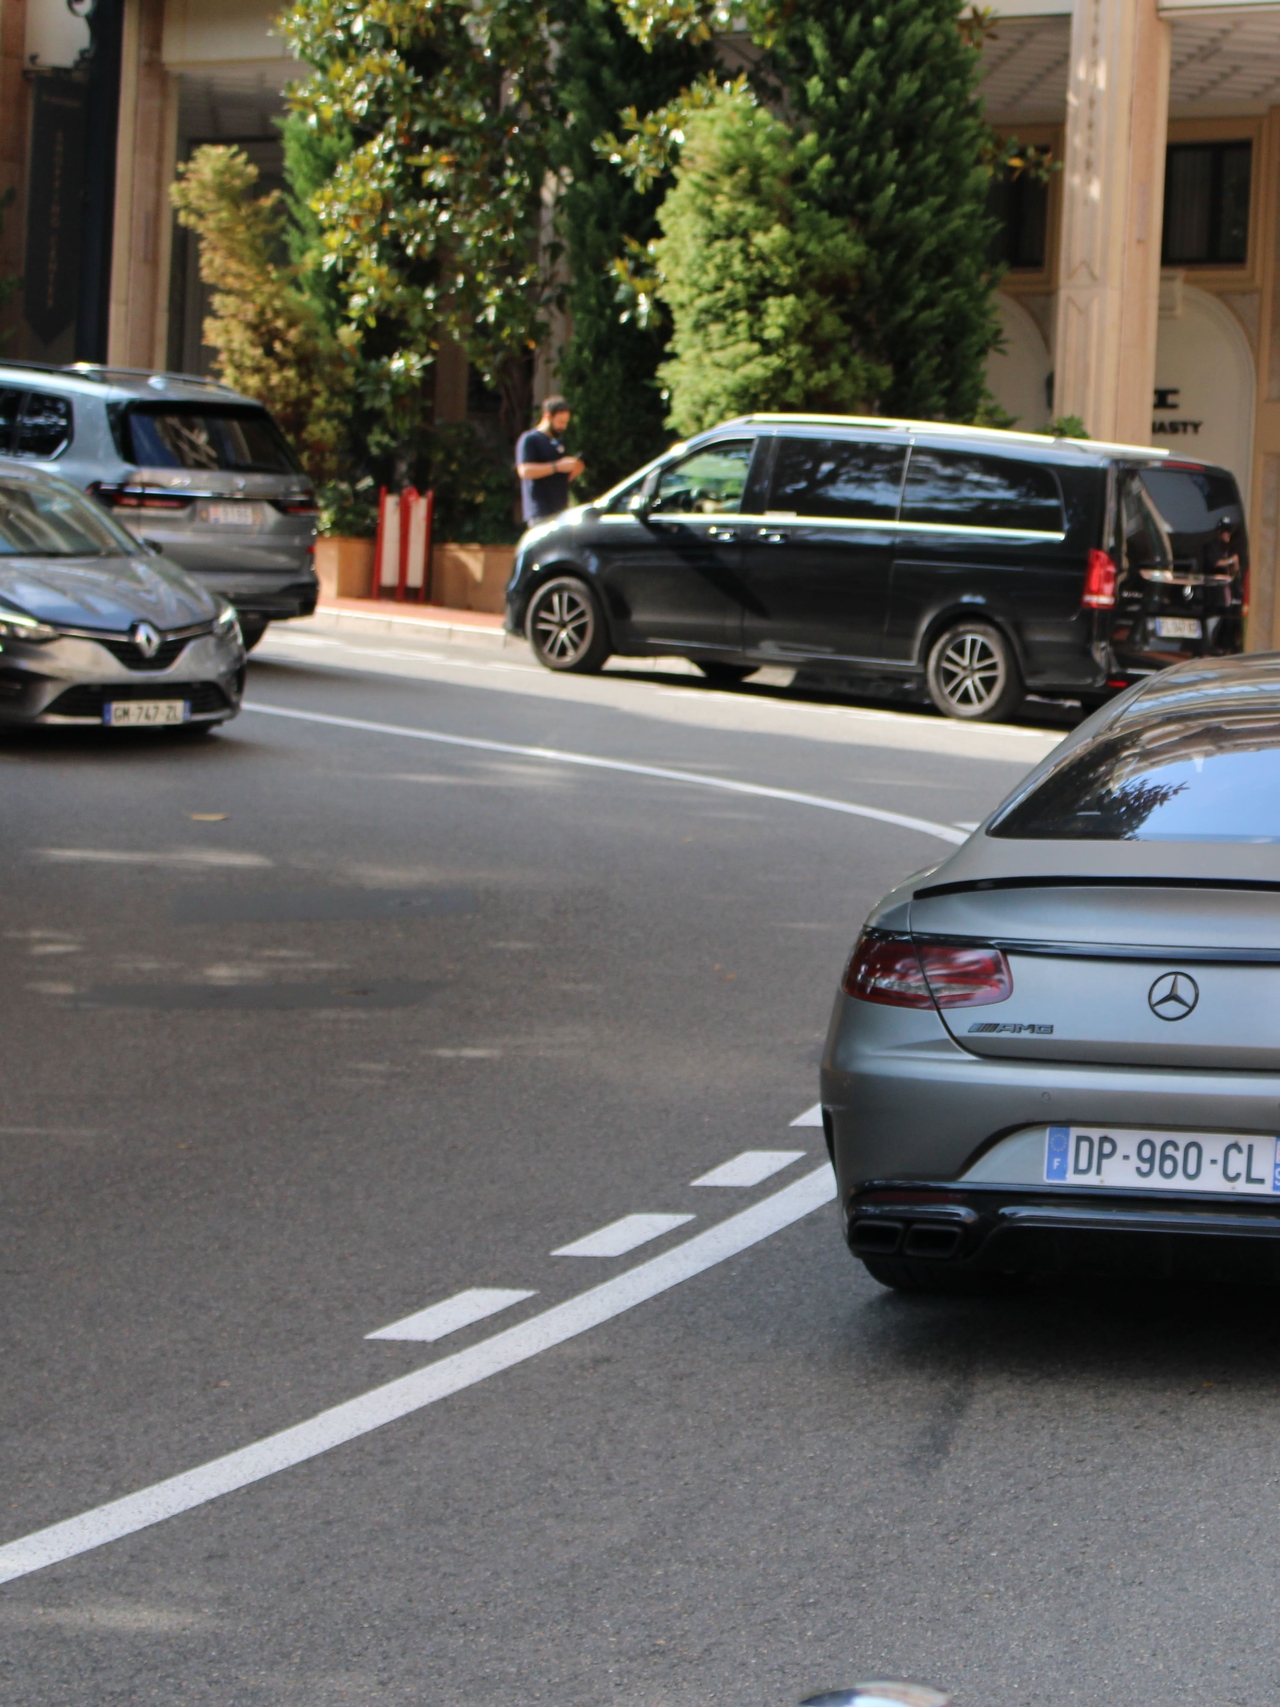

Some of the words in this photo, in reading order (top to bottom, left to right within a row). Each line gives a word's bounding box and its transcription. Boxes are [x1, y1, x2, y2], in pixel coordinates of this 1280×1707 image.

[995, 1022, 1054, 1035] AMG
[1052, 1158, 1061, 1170] F
[1072, 1134, 1266, 1185] DP-960-CL
